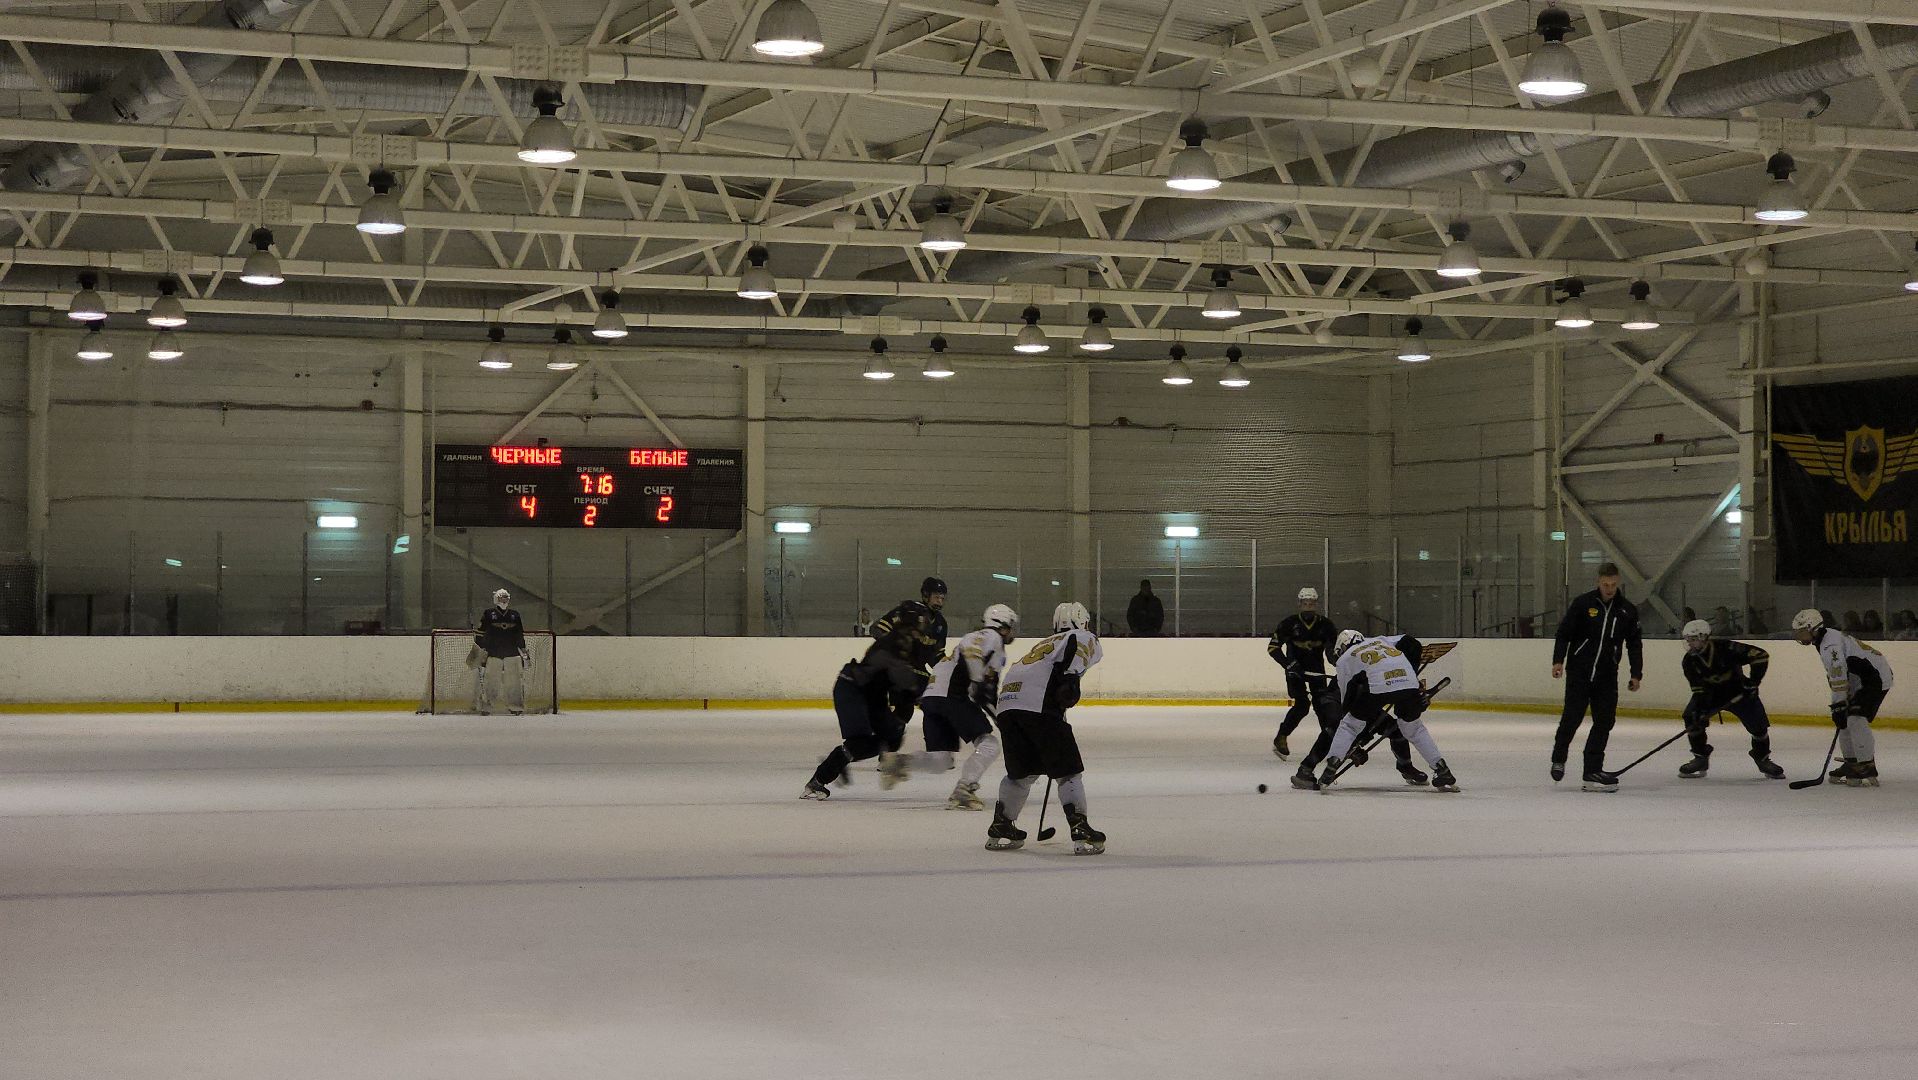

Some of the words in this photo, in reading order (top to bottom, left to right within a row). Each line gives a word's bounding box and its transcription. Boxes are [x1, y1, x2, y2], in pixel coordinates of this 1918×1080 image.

[491, 447, 562, 465] ЧЕРНЫЕ
[630, 450, 689, 466] БЕЛЫЕ
[505, 484, 537, 494] СЧЕТ
[580, 473, 613, 495] 7:16
[643, 486, 675, 495] СЧЕТ
[521, 496, 537, 518] 4
[573, 496, 608, 505] ПЕРИОД
[656, 496, 673, 521] 2
[583, 505, 597, 526] 2
[1825, 510, 1908, 544] КРЫЛЬЯ
